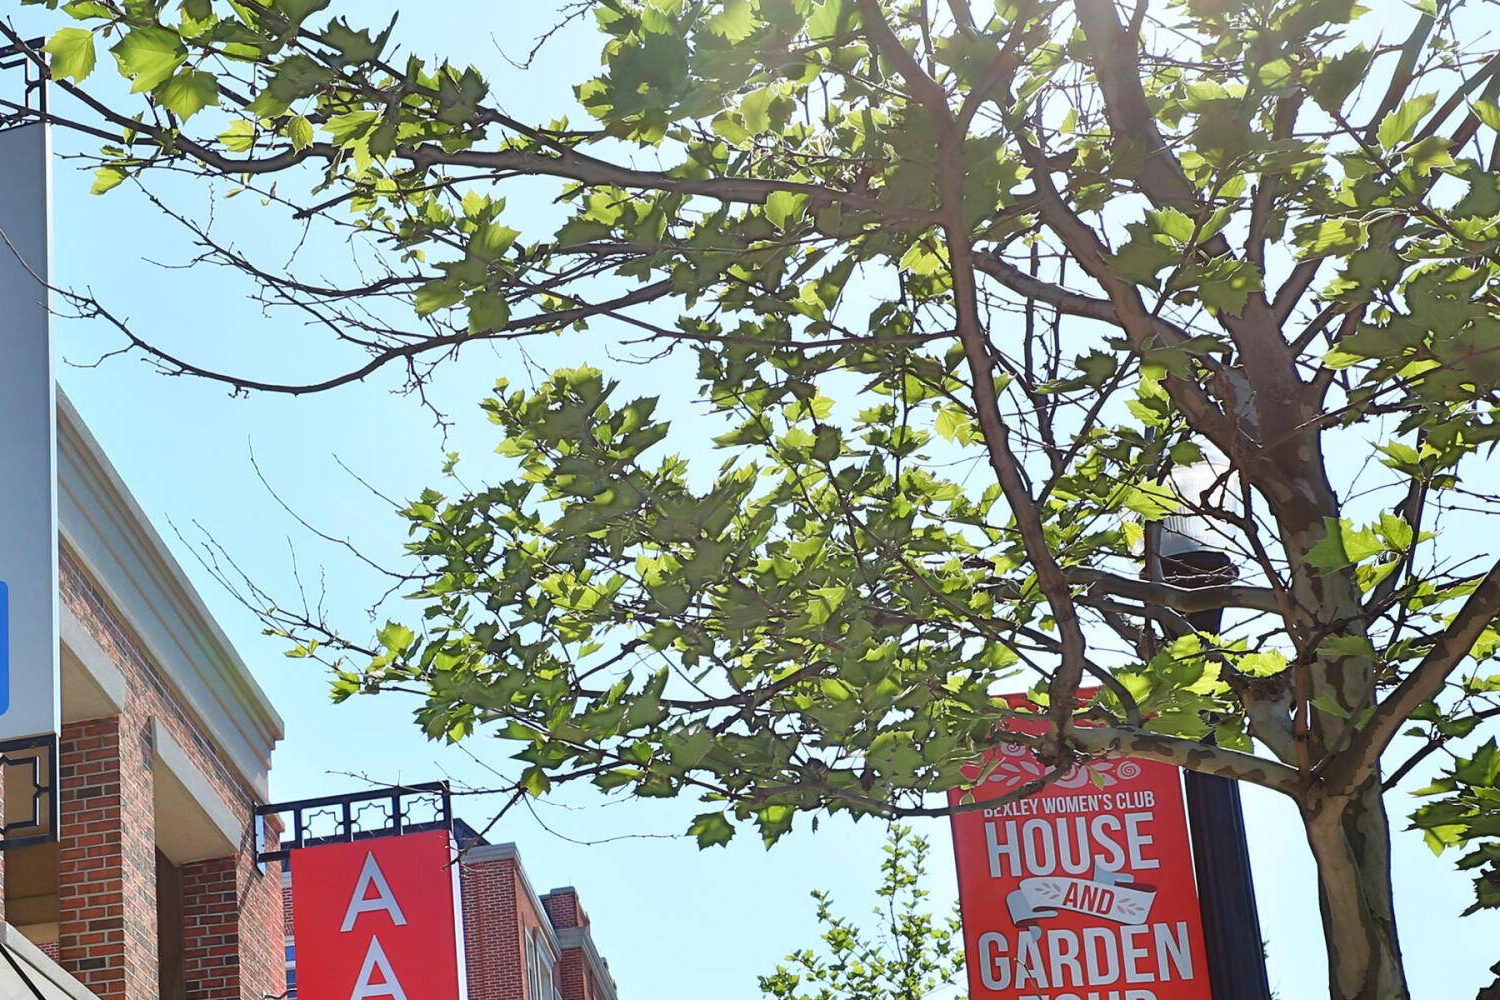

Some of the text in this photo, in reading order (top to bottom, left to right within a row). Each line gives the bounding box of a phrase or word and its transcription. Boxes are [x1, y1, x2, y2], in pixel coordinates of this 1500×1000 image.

[984, 790, 1156, 818] BEXLEY WOMEN'S CLUB
[983, 812, 1160, 879] HOUSE
[1061, 882, 1115, 915] AND
[978, 921, 1195, 991] GARDEN
